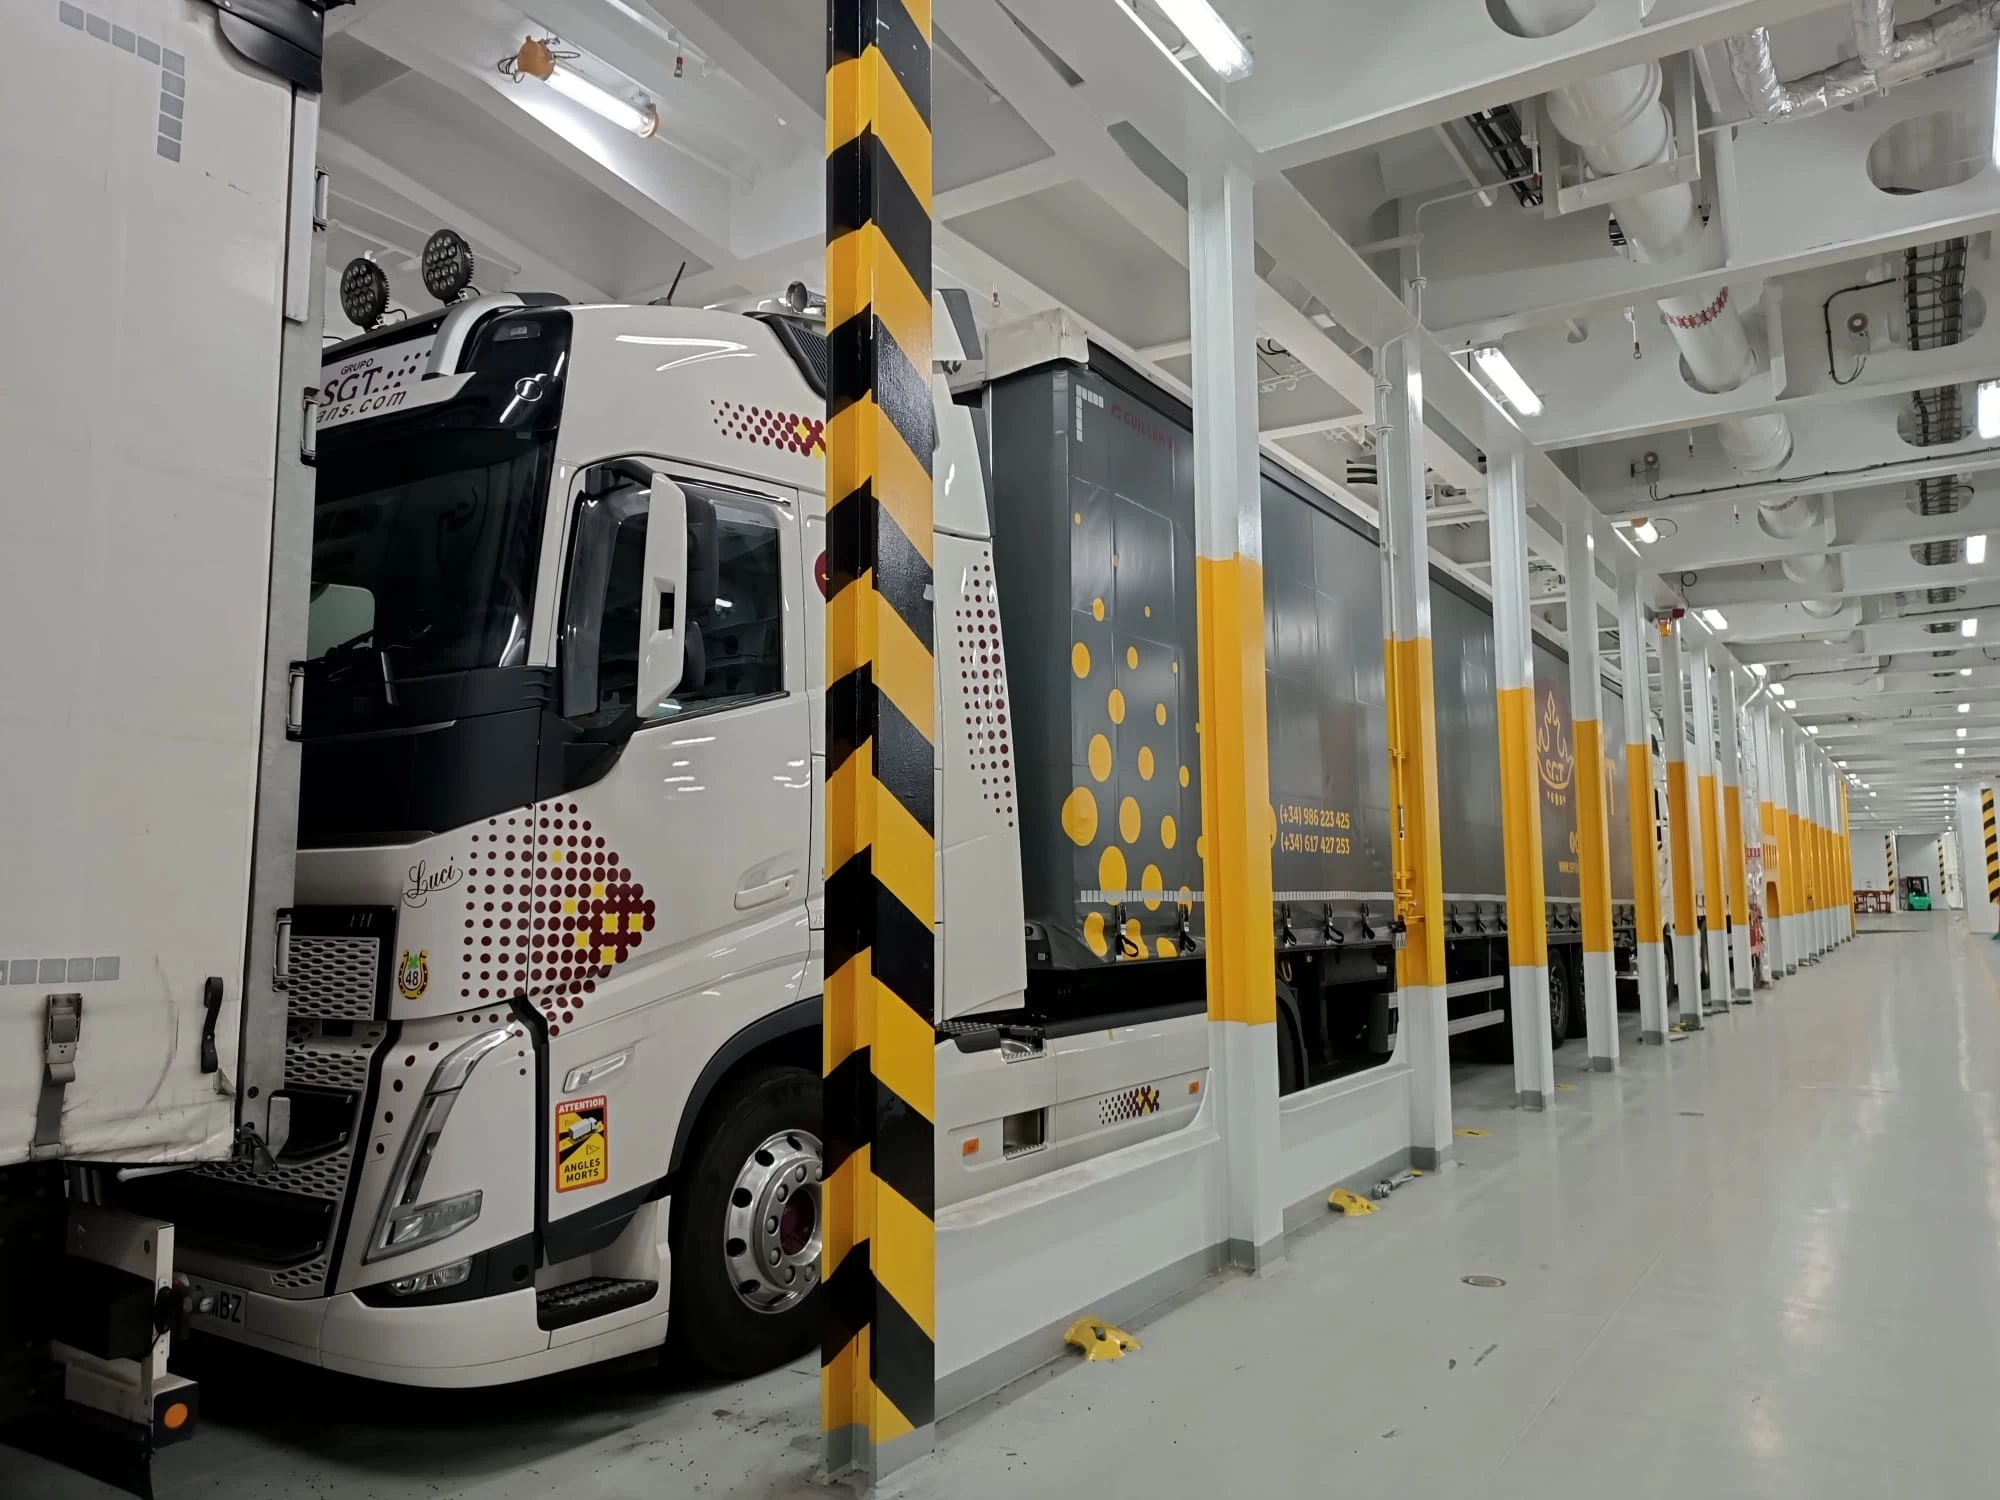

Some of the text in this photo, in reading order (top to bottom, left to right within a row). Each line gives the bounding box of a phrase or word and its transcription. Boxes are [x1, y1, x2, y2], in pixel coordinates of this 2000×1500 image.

[340, 358, 374, 375] GRUPO
[319, 366, 383, 408] SGT
[1280, 803, 1350, 829] (+34) 986 223 425
[1280, 831, 1350, 855] (+34) 617 427 253
[402, 856, 463, 908] Luci
[405, 970, 419, 986] 48
[559, 1097, 605, 1114] ATTENTION
[564, 1158, 601, 1174] ANGLES
[566, 1168, 599, 1183] MORTS
